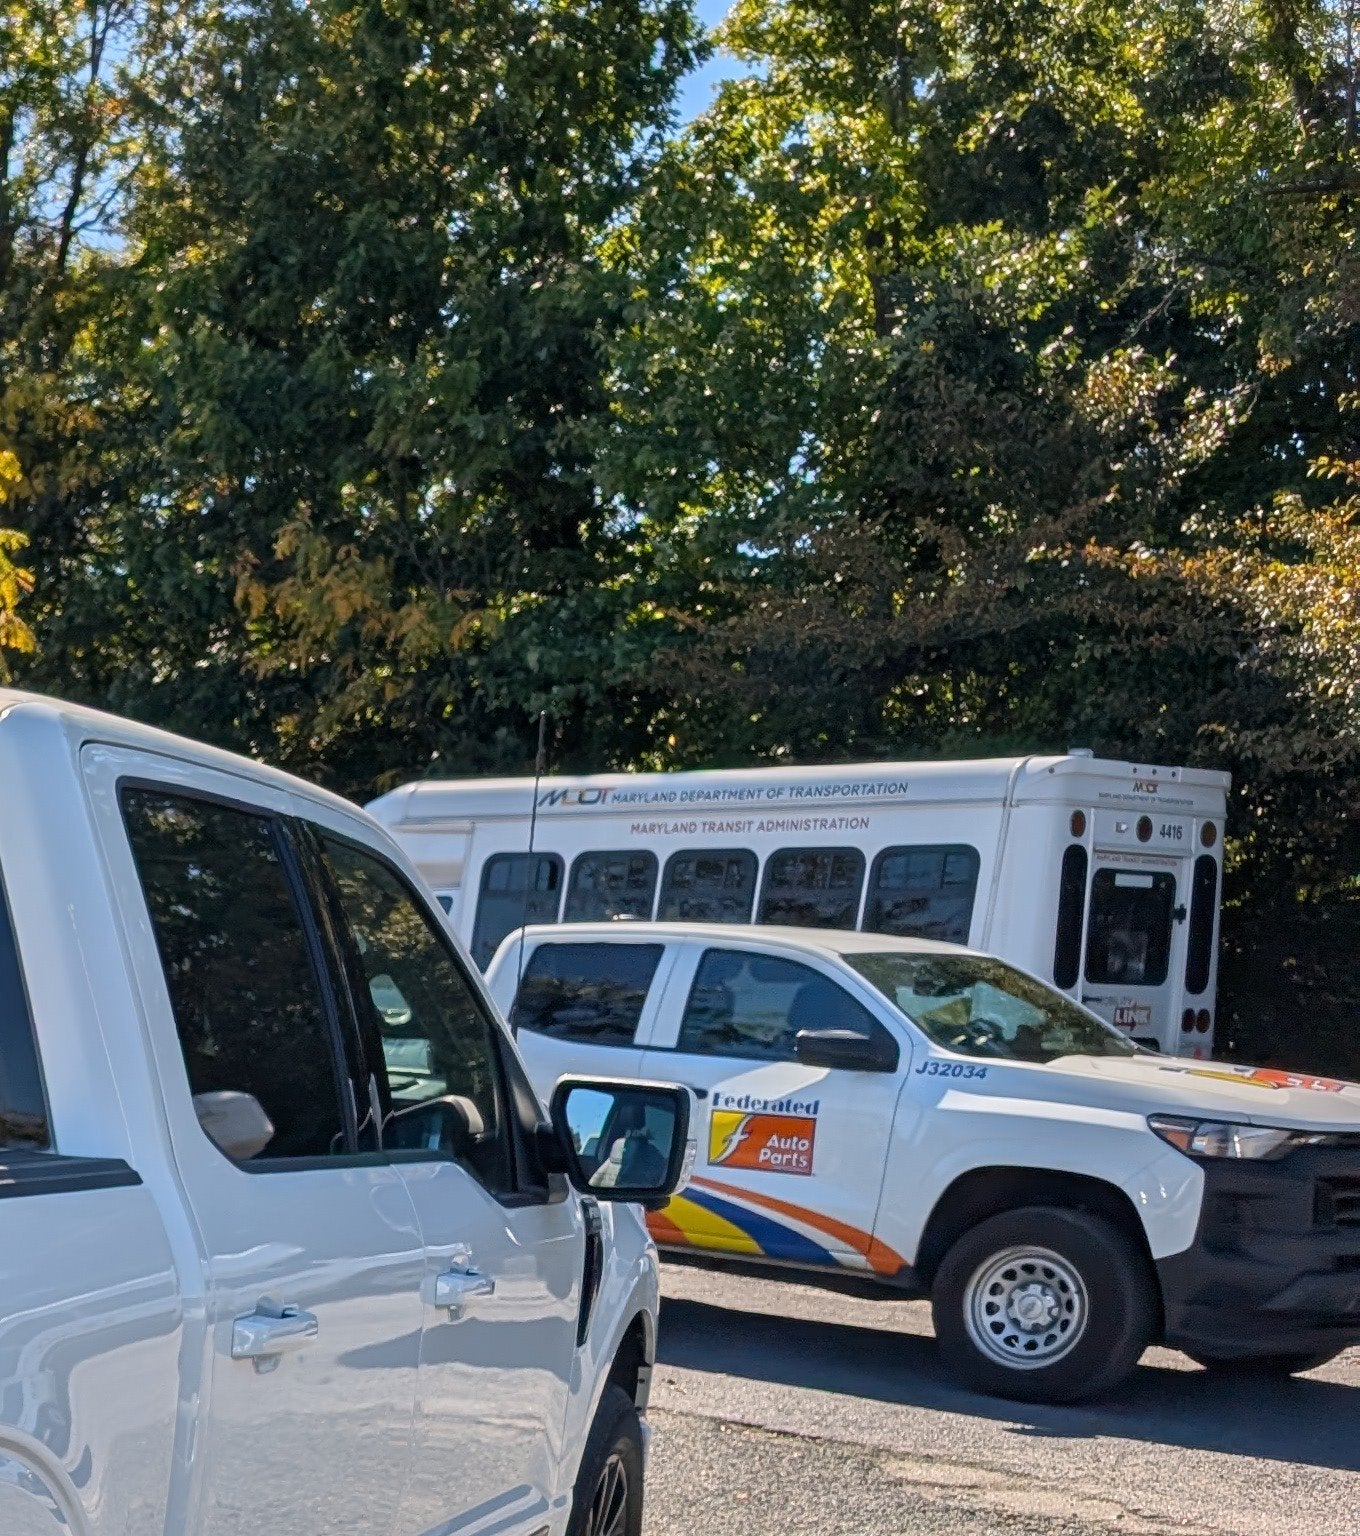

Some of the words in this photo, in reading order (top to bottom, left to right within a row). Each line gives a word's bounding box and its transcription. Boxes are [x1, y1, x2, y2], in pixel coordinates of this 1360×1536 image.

[612, 792, 678, 804] MARYLAND
[680, 786, 763, 803] DEPARTMENT
[766, 786, 785, 799] OF
[788, 781, 909, 799] TRANSPORTATION
[631, 820, 697, 834] MARYLAND
[701, 819, 753, 833] TRANSIT
[755, 816, 870, 832] ADMINISTRATION
[915, 1061, 988, 1080] J32034
[712, 1091, 820, 1115] Federated
[766, 1133, 810, 1152] Auto
[759, 1147, 809, 1168] Parts
